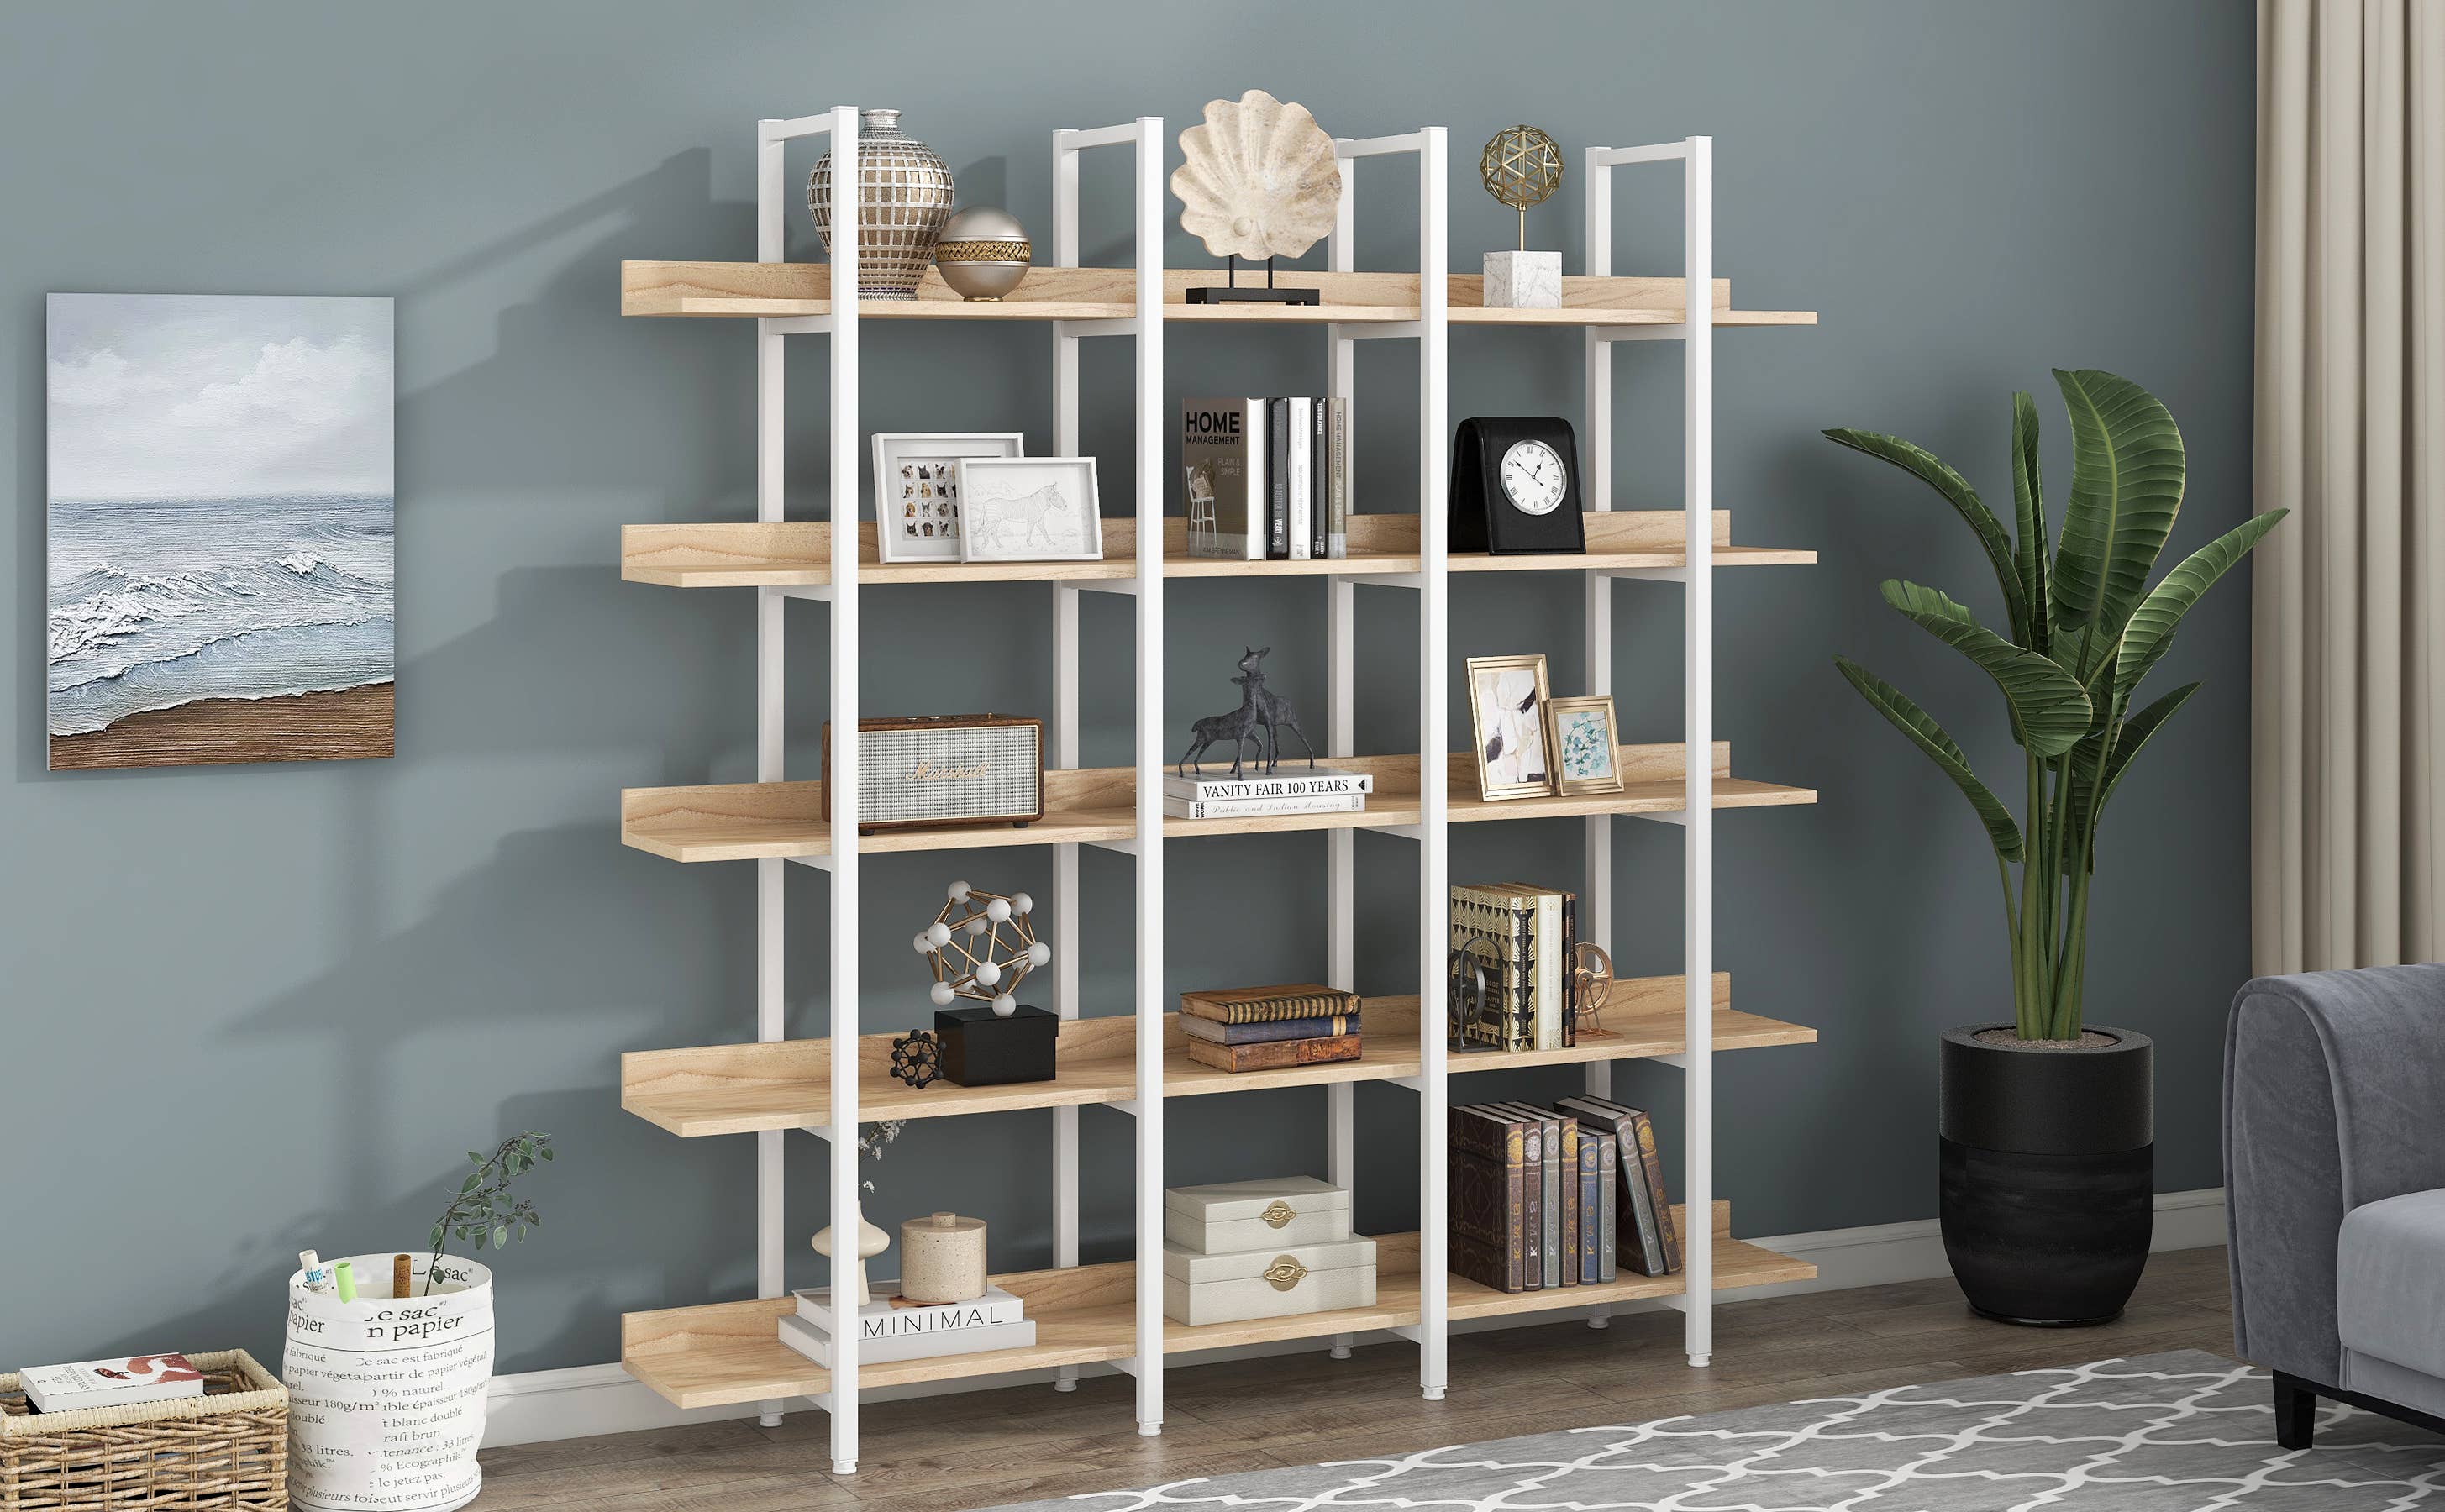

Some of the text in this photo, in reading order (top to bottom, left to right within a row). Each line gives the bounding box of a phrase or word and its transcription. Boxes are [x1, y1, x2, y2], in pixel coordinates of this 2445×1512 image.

[1186, 412, 1240, 433] HOME
[1186, 436, 1240, 445] MANAGEMENT
[905, 759, 991, 780] Marshall
[1203, 780, 1349, 798] VANITY FAIR 100 YEARS
[444, 1268, 468, 1282] sac
[399, 1306, 438, 1321] sac
[289, 1310, 325, 1333] papier
[364, 1315, 464, 1341] n papier
[865, 1306, 1003, 1338] MINIMAL
[290, 1347, 326, 1362] fabriqué
[377, 1357, 398, 1366] sac
[423, 1345, 463, 1362] fabriqué
[288, 1365, 318, 1377] papier
[409, 1369, 424, 1378] de
[428, 1363, 458, 1378] papier
[413, 1394, 458, 1411] épaisseur
[392, 1417, 428, 1428] blanc
[430, 1407, 463, 1423] doublé
[412, 1430, 440, 1441] brun
[302, 1444, 312, 1453] 33
[442, 1439, 455, 1451] 33
[379, 1478, 390, 1488] le
[393, 1476, 421, 1489] jetez
[306, 1485, 351, 1501] plusieurs
[405, 1488, 439, 1501] servir
